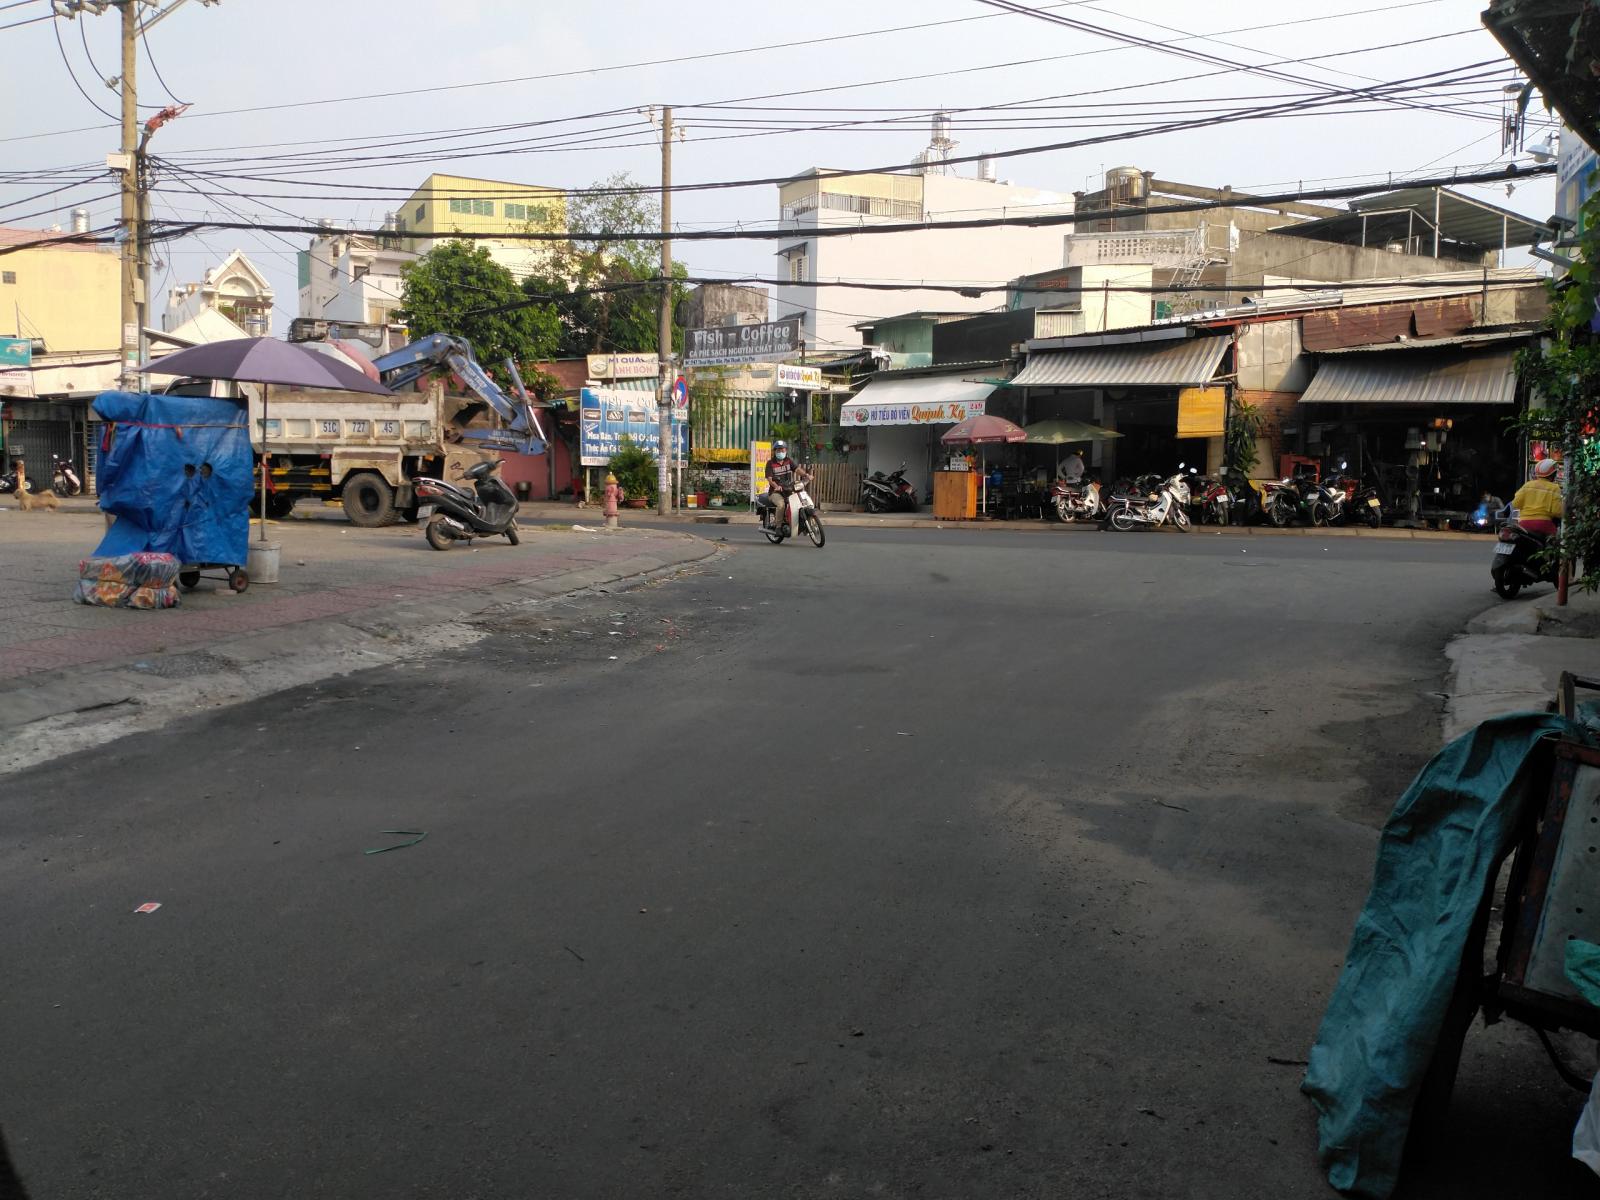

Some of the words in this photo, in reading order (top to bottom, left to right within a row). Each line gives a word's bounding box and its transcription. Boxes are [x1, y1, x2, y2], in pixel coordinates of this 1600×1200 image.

[693, 330, 723, 345] Fish
[741, 325, 790, 344] Coffee
[322, 421, 337, 433] 51C
[352, 421, 366, 433] 727
